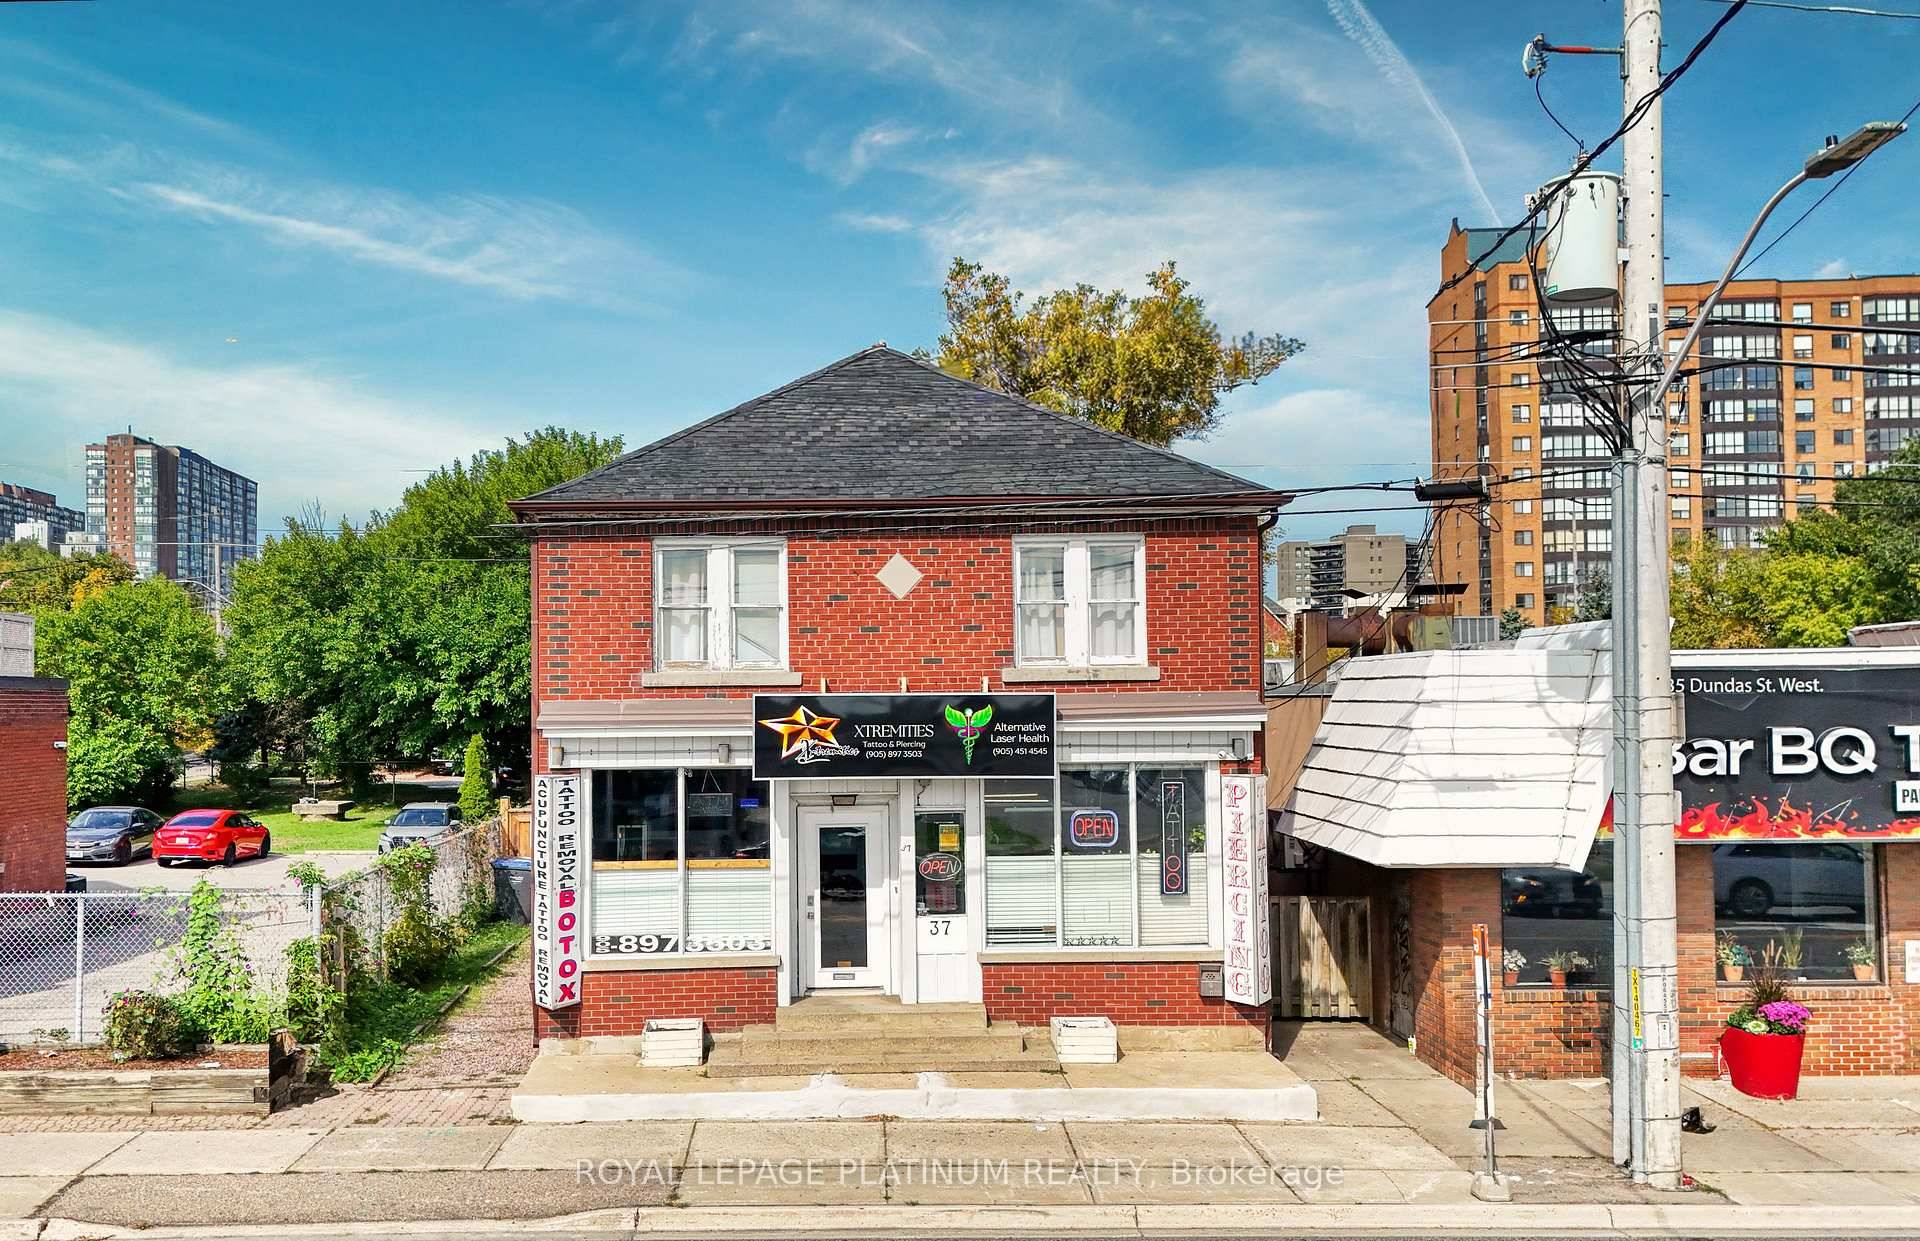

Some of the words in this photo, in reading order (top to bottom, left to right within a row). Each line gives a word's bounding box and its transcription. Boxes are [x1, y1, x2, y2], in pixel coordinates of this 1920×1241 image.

[1690, 677, 1752, 692] Dundas
[1756, 677, 1776, 692] St.
[1779, 677, 1824, 692] West.
[853, 724, 934, 738] XTREMITIES
[994, 722, 1047, 732] Alternative
[896, 740, 926, 749] Piercing
[990, 733, 1017, 743] Laser
[1018, 733, 1050, 743] Health
[865, 750, 887, 759] (905)
[888, 750, 902, 758] 897
[903, 750, 923, 758] 3503
[992, 747, 1014, 757] (905)
[1015, 747, 1028, 755] 451
[1028, 747, 1048, 755] 4545
[1771, 726, 1878, 776] BQ
[558, 779, 576, 826] TATTOO
[1902, 789, 1920, 803] PA
[537, 780, 548, 889] ACUPUNCTURE
[1074, 817, 1114, 837] OPEN
[558, 834, 577, 890] REMOVAL
[921, 860, 958, 875] OPEN
[537, 894, 548, 941] TATTOO
[929, 920, 952, 935] 37
[557, 890, 578, 1003] BOTOX
[537, 948, 549, 1004] REMOVAL
